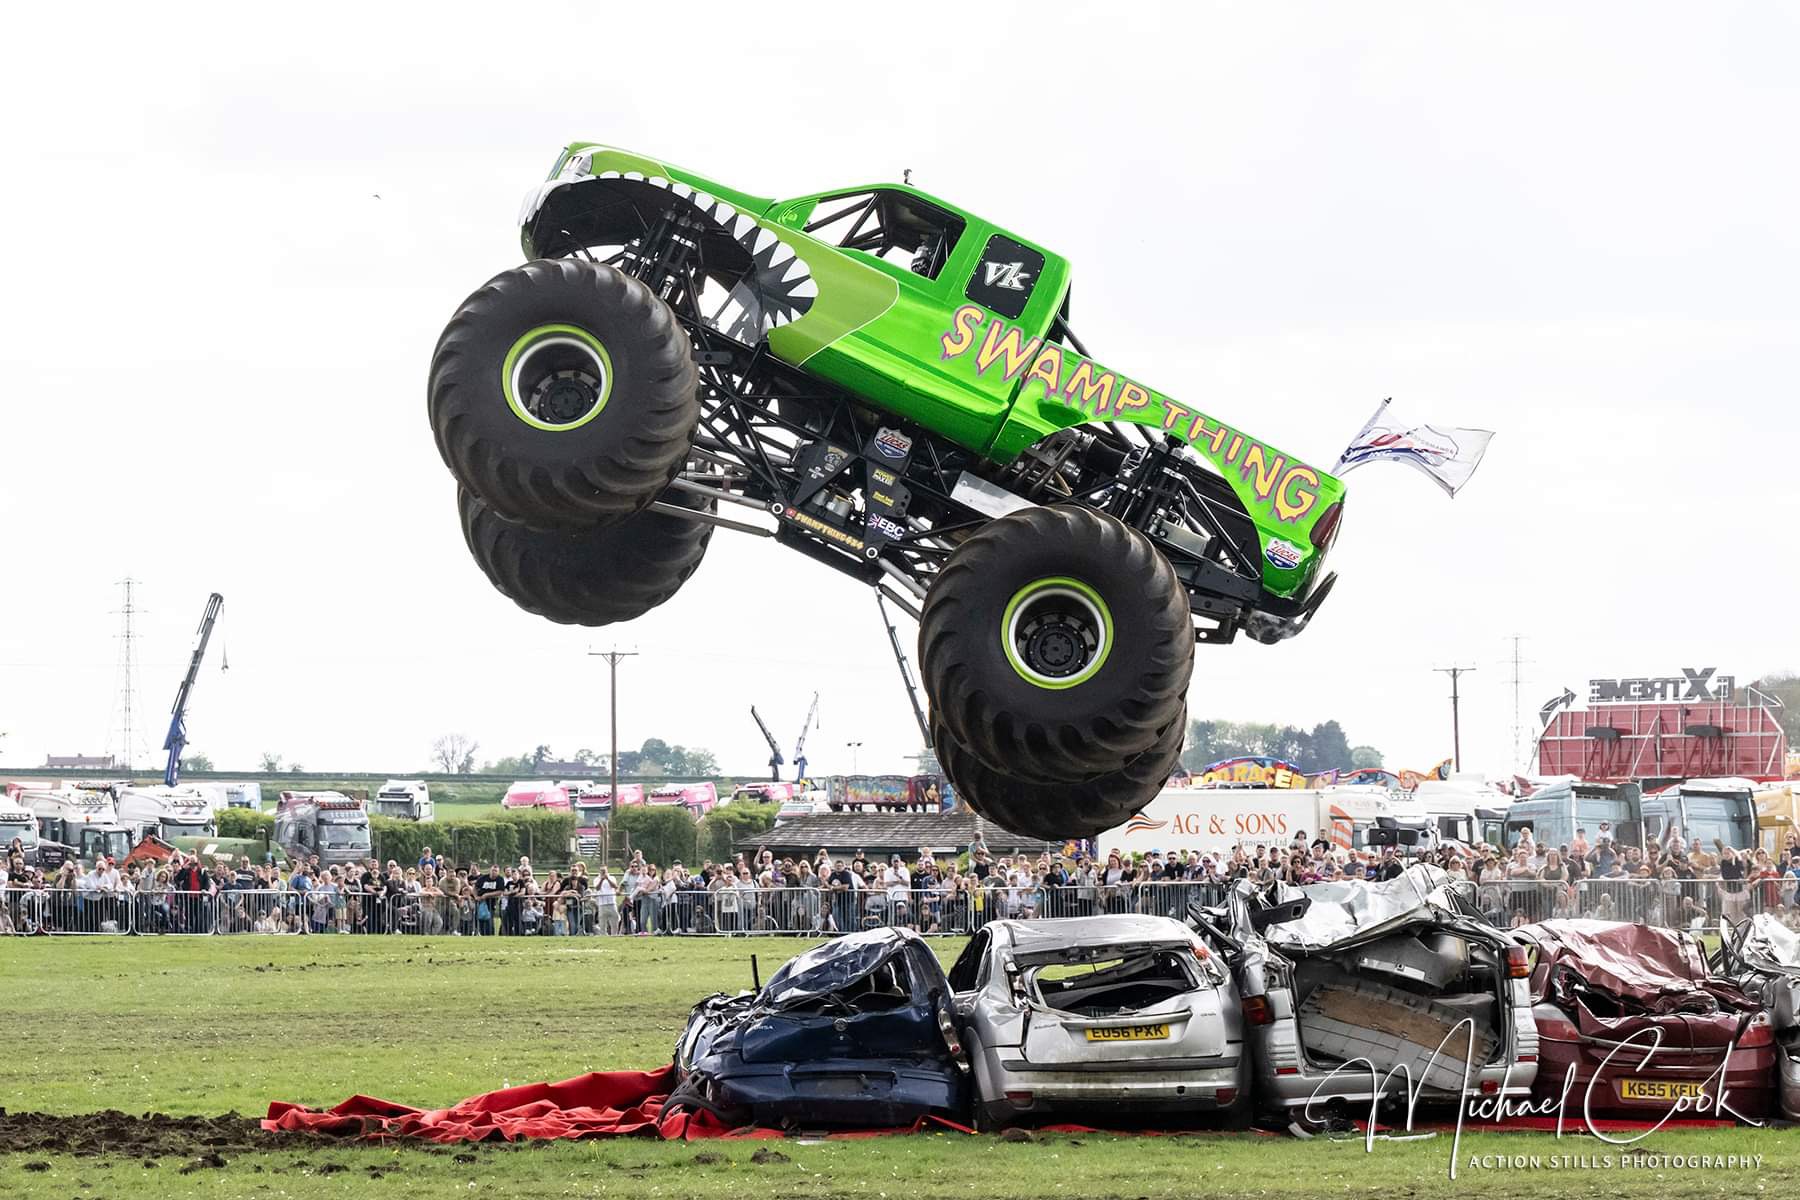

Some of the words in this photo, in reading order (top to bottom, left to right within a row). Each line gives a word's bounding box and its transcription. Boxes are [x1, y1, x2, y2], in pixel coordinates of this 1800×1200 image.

[941, 305, 1150, 416] SWAMP
[1163, 400, 1319, 523] THING
[878, 518, 905, 537] EBC
[1171, 813, 1200, 835] AG
[1208, 814, 1226, 835] &
[1235, 813, 1287, 835] SONS
[1134, 1024, 1164, 1038] PXK
[1628, 1082, 1666, 1097] K655
